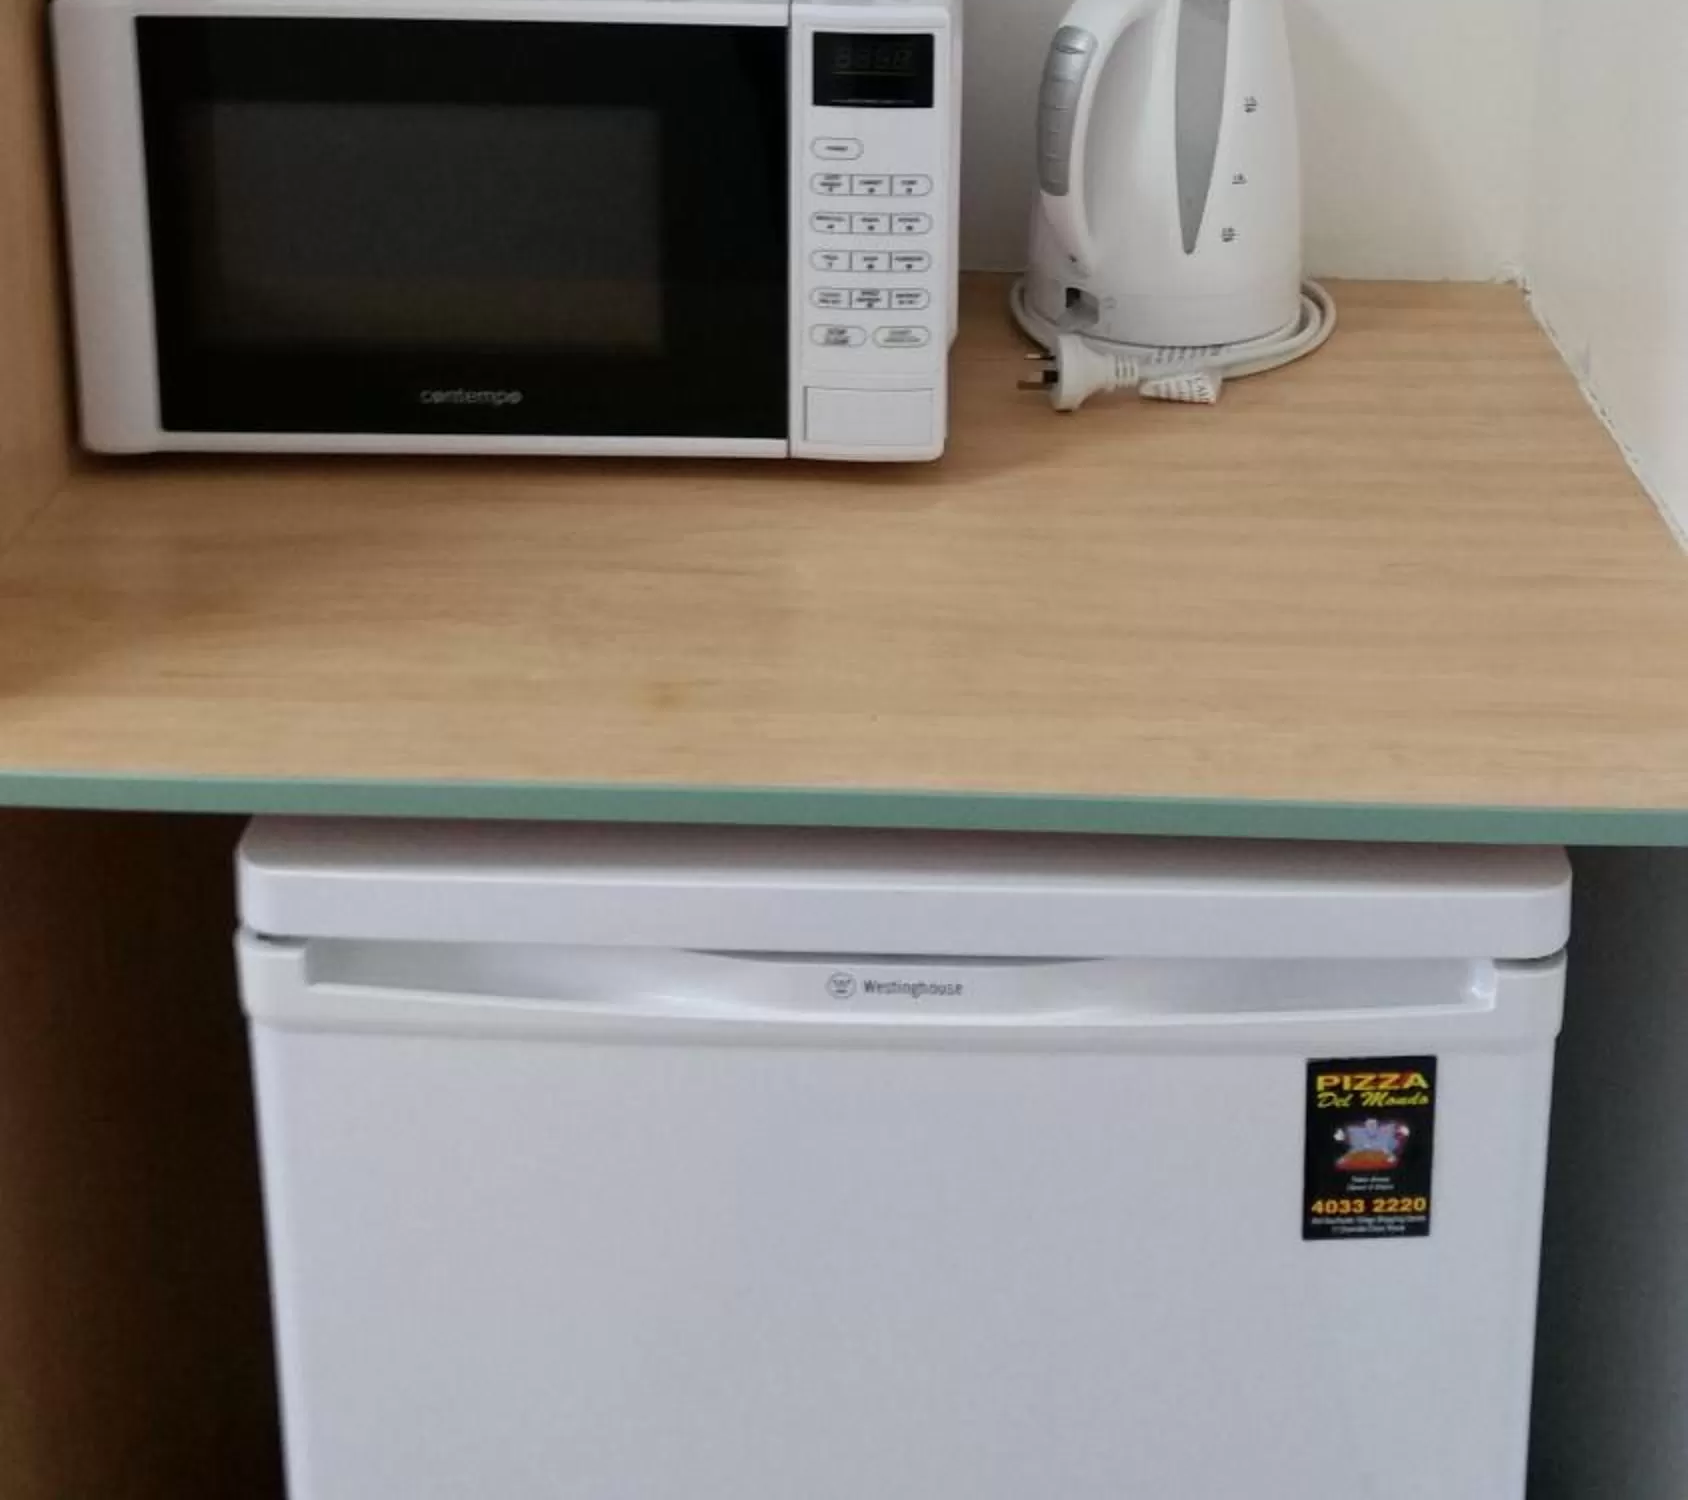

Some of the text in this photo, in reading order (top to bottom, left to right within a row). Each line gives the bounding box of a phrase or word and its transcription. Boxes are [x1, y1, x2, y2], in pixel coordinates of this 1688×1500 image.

[863, 979, 964, 999] Westinghouse
[1316, 1073, 1428, 1090] PIZZA
[1317, 1091, 1429, 1108] Del Mondo
[1311, 1197, 1426, 1214] 4033 2220
